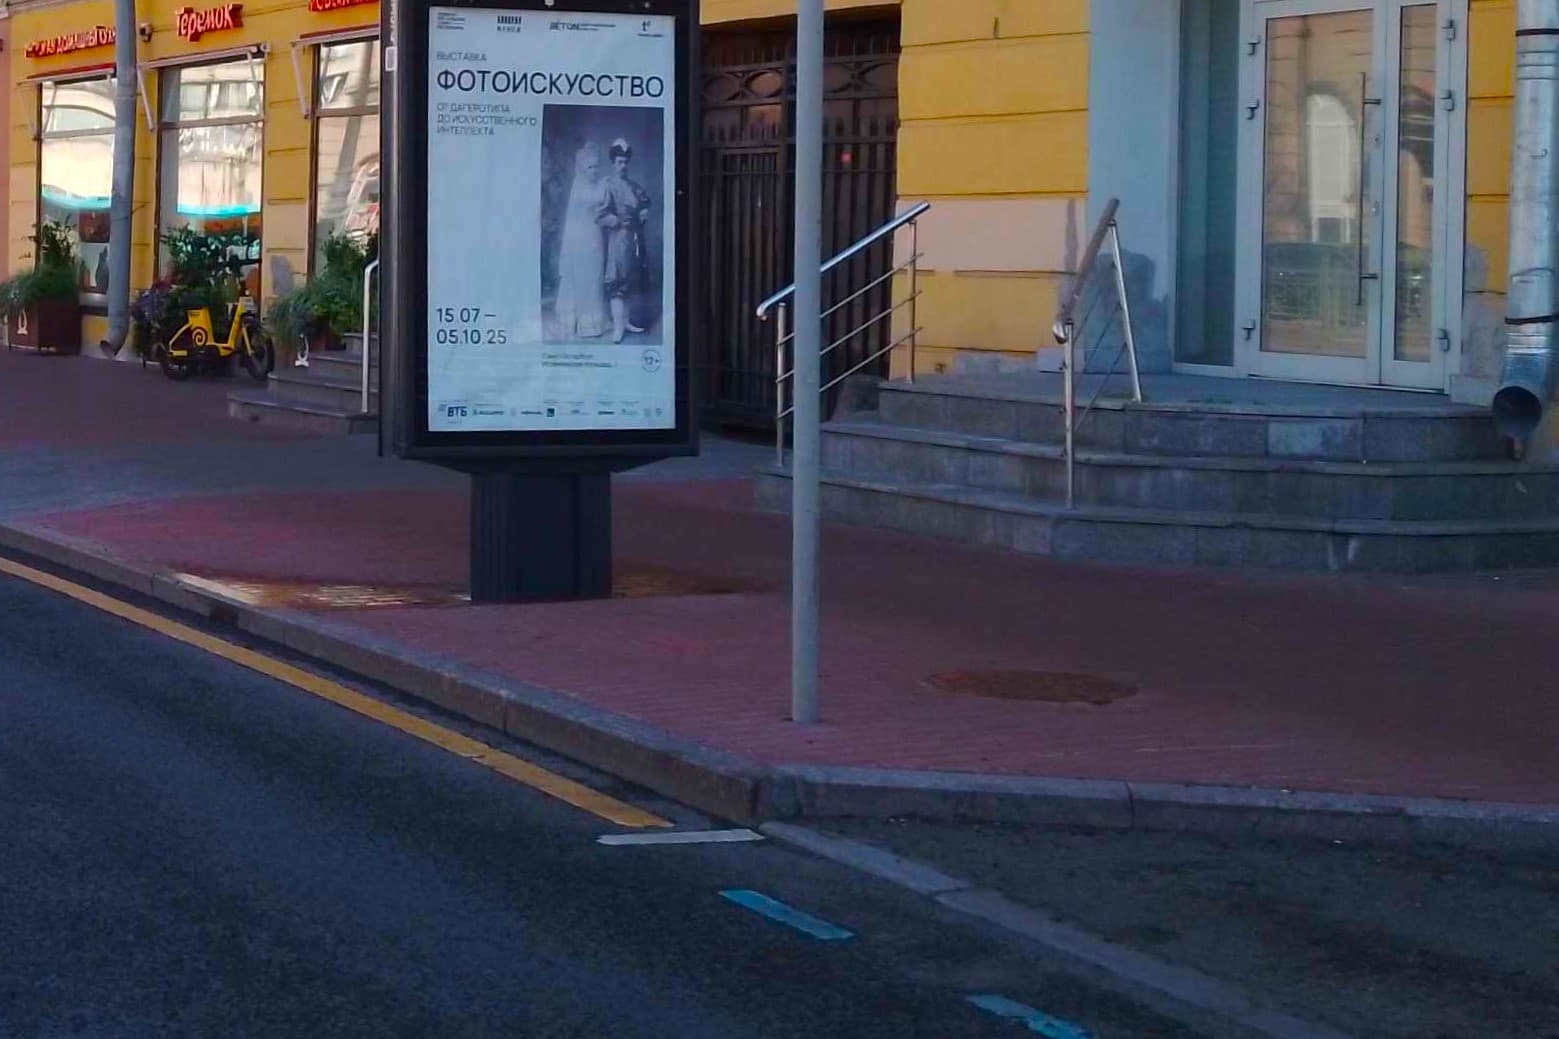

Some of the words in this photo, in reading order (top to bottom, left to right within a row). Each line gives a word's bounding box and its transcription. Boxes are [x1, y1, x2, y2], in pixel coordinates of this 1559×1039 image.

[437, 51, 487, 61] ВЫСТАВКА
[437, 69, 665, 98] ФОТОИСКУССТВО
[452, 115, 537, 127] ИСКУССТВЕННОГО
[437, 126, 495, 136] ИНТЕЛЛЕКТА
[436, 329, 507, 345] 05.10.25
